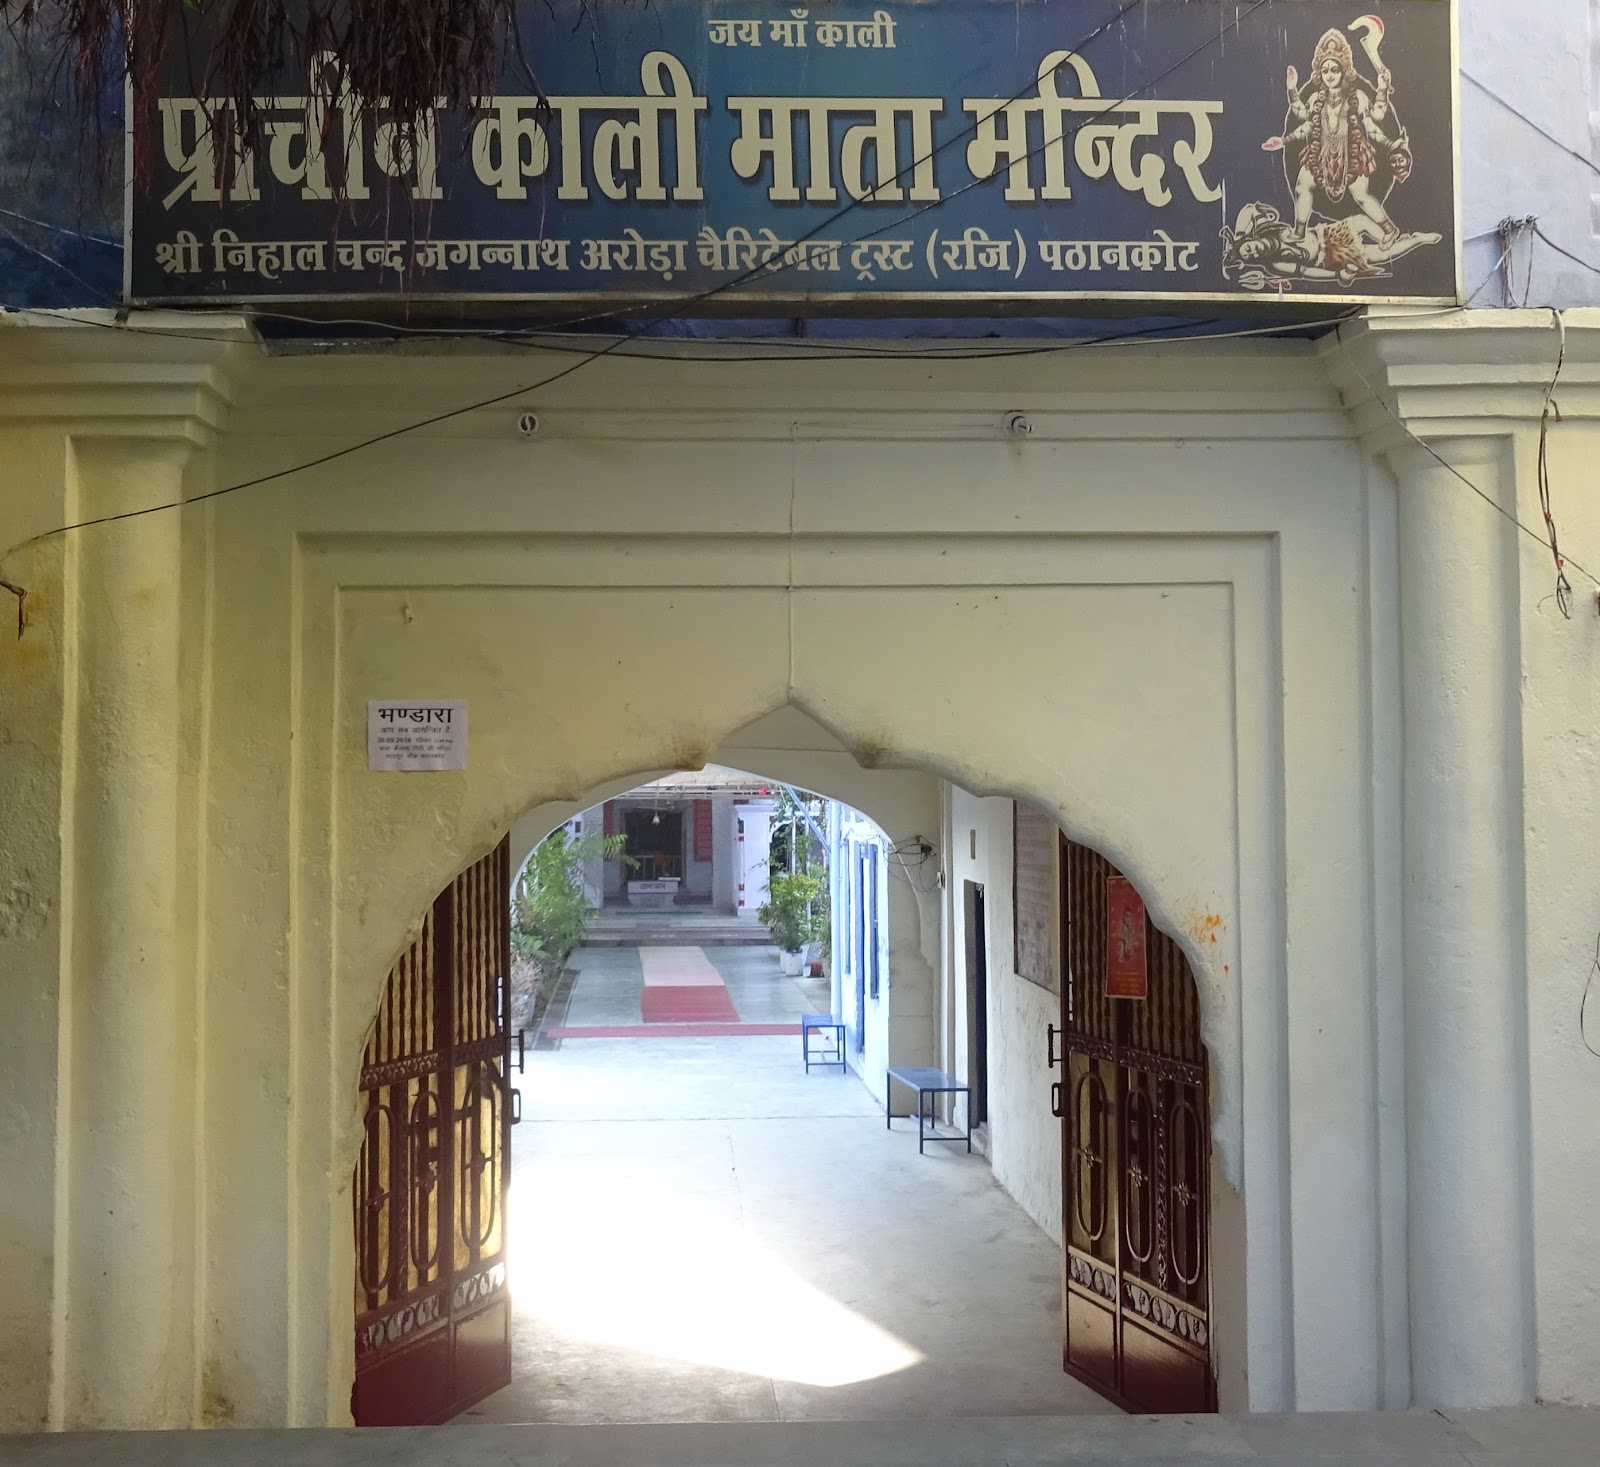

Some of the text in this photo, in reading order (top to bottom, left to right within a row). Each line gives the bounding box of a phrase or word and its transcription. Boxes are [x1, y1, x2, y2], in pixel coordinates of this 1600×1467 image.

[708, 7, 896, 49] जय माँ काली
[470, 51, 708, 201] काली
[727, 96, 944, 203] माता
[962, 50, 1224, 207] मन्दिर
[154, 226, 1200, 282] श्री निहाल चन्द जगन्नाथ अरोड़ा चैरिटेबल ट्रस्ट (रजि) पठानकोट
[378, 708, 453, 723] भण्डारा
